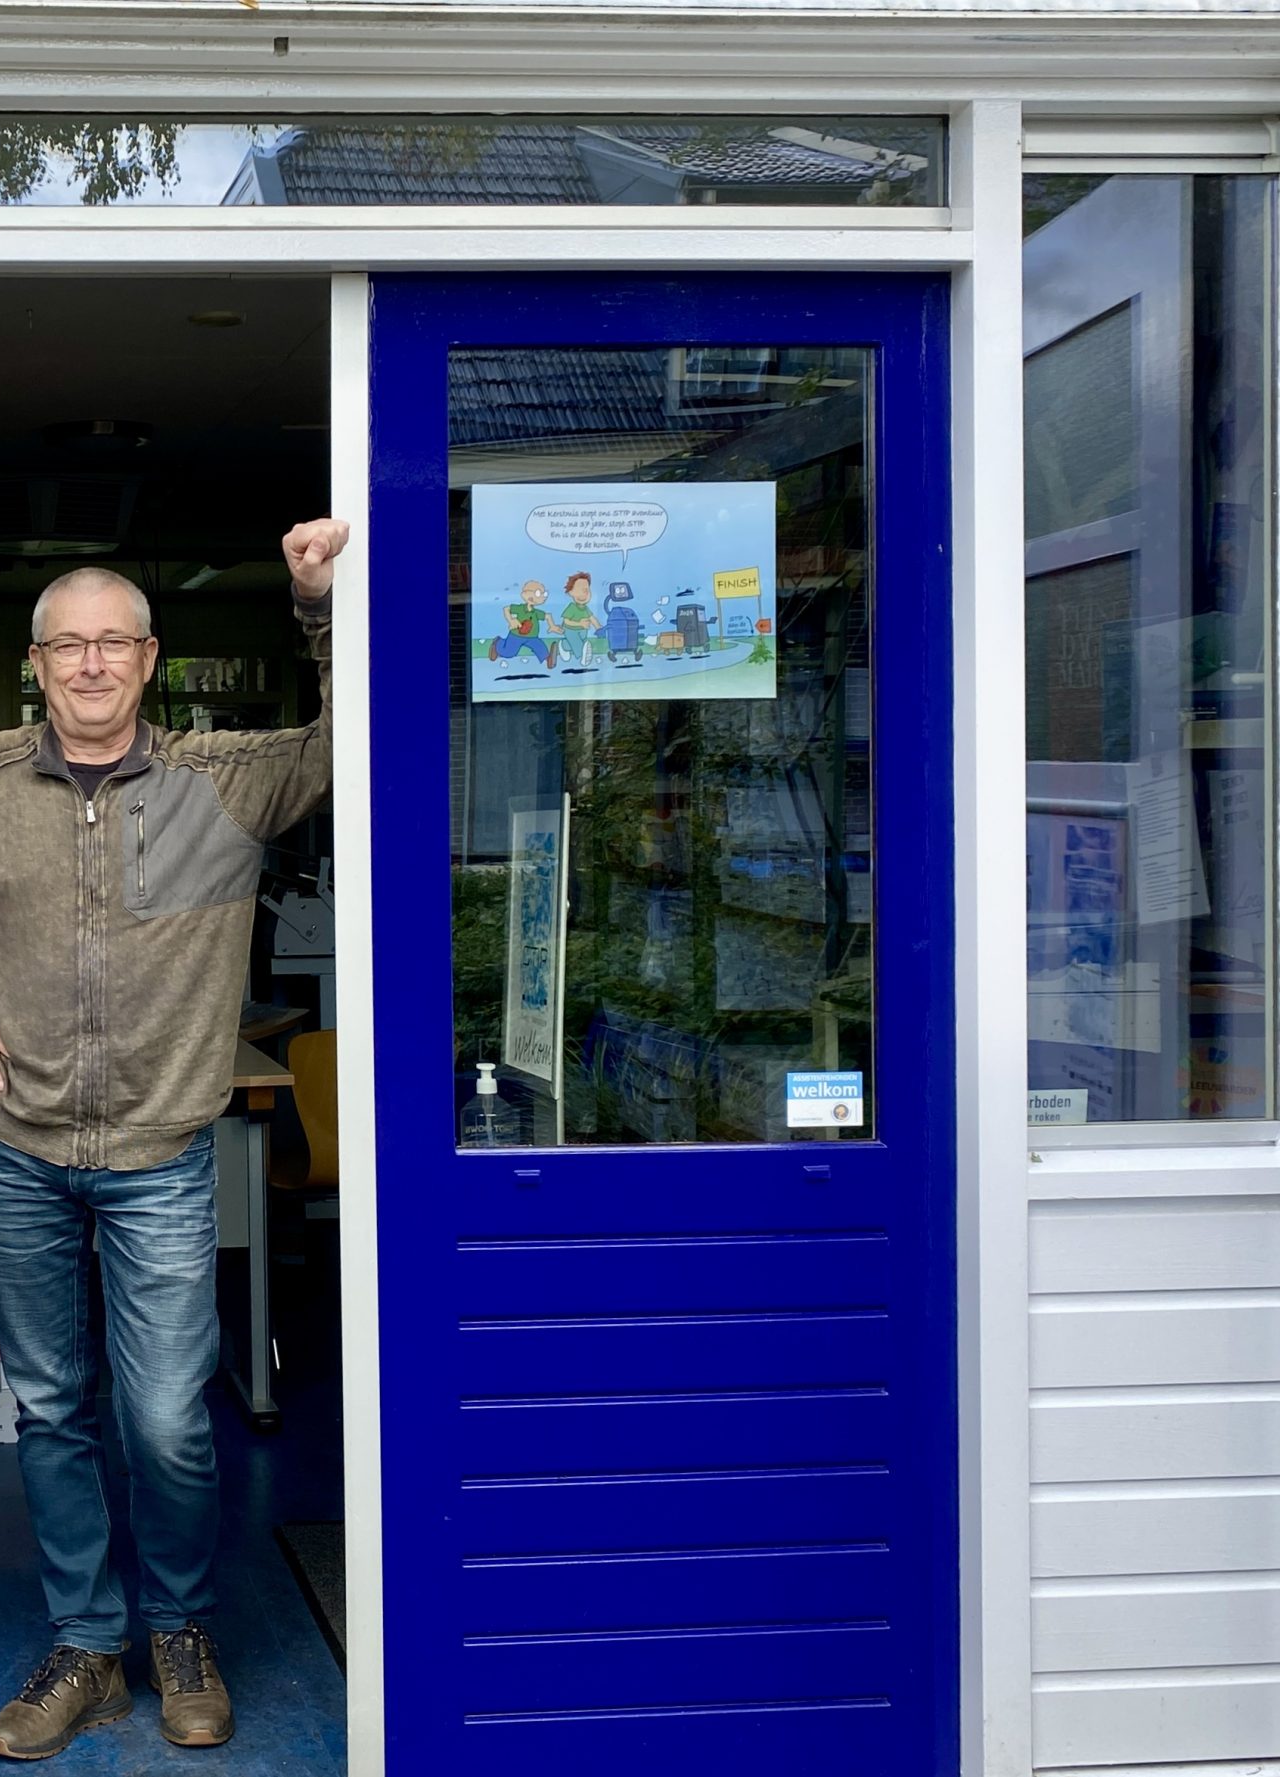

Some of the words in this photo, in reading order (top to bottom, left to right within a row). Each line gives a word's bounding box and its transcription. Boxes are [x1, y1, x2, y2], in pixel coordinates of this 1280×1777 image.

[717, 577, 757, 590] FINISH
[793, 1082, 858, 1097] welkom
[1034, 1112, 1061, 1121] roken
